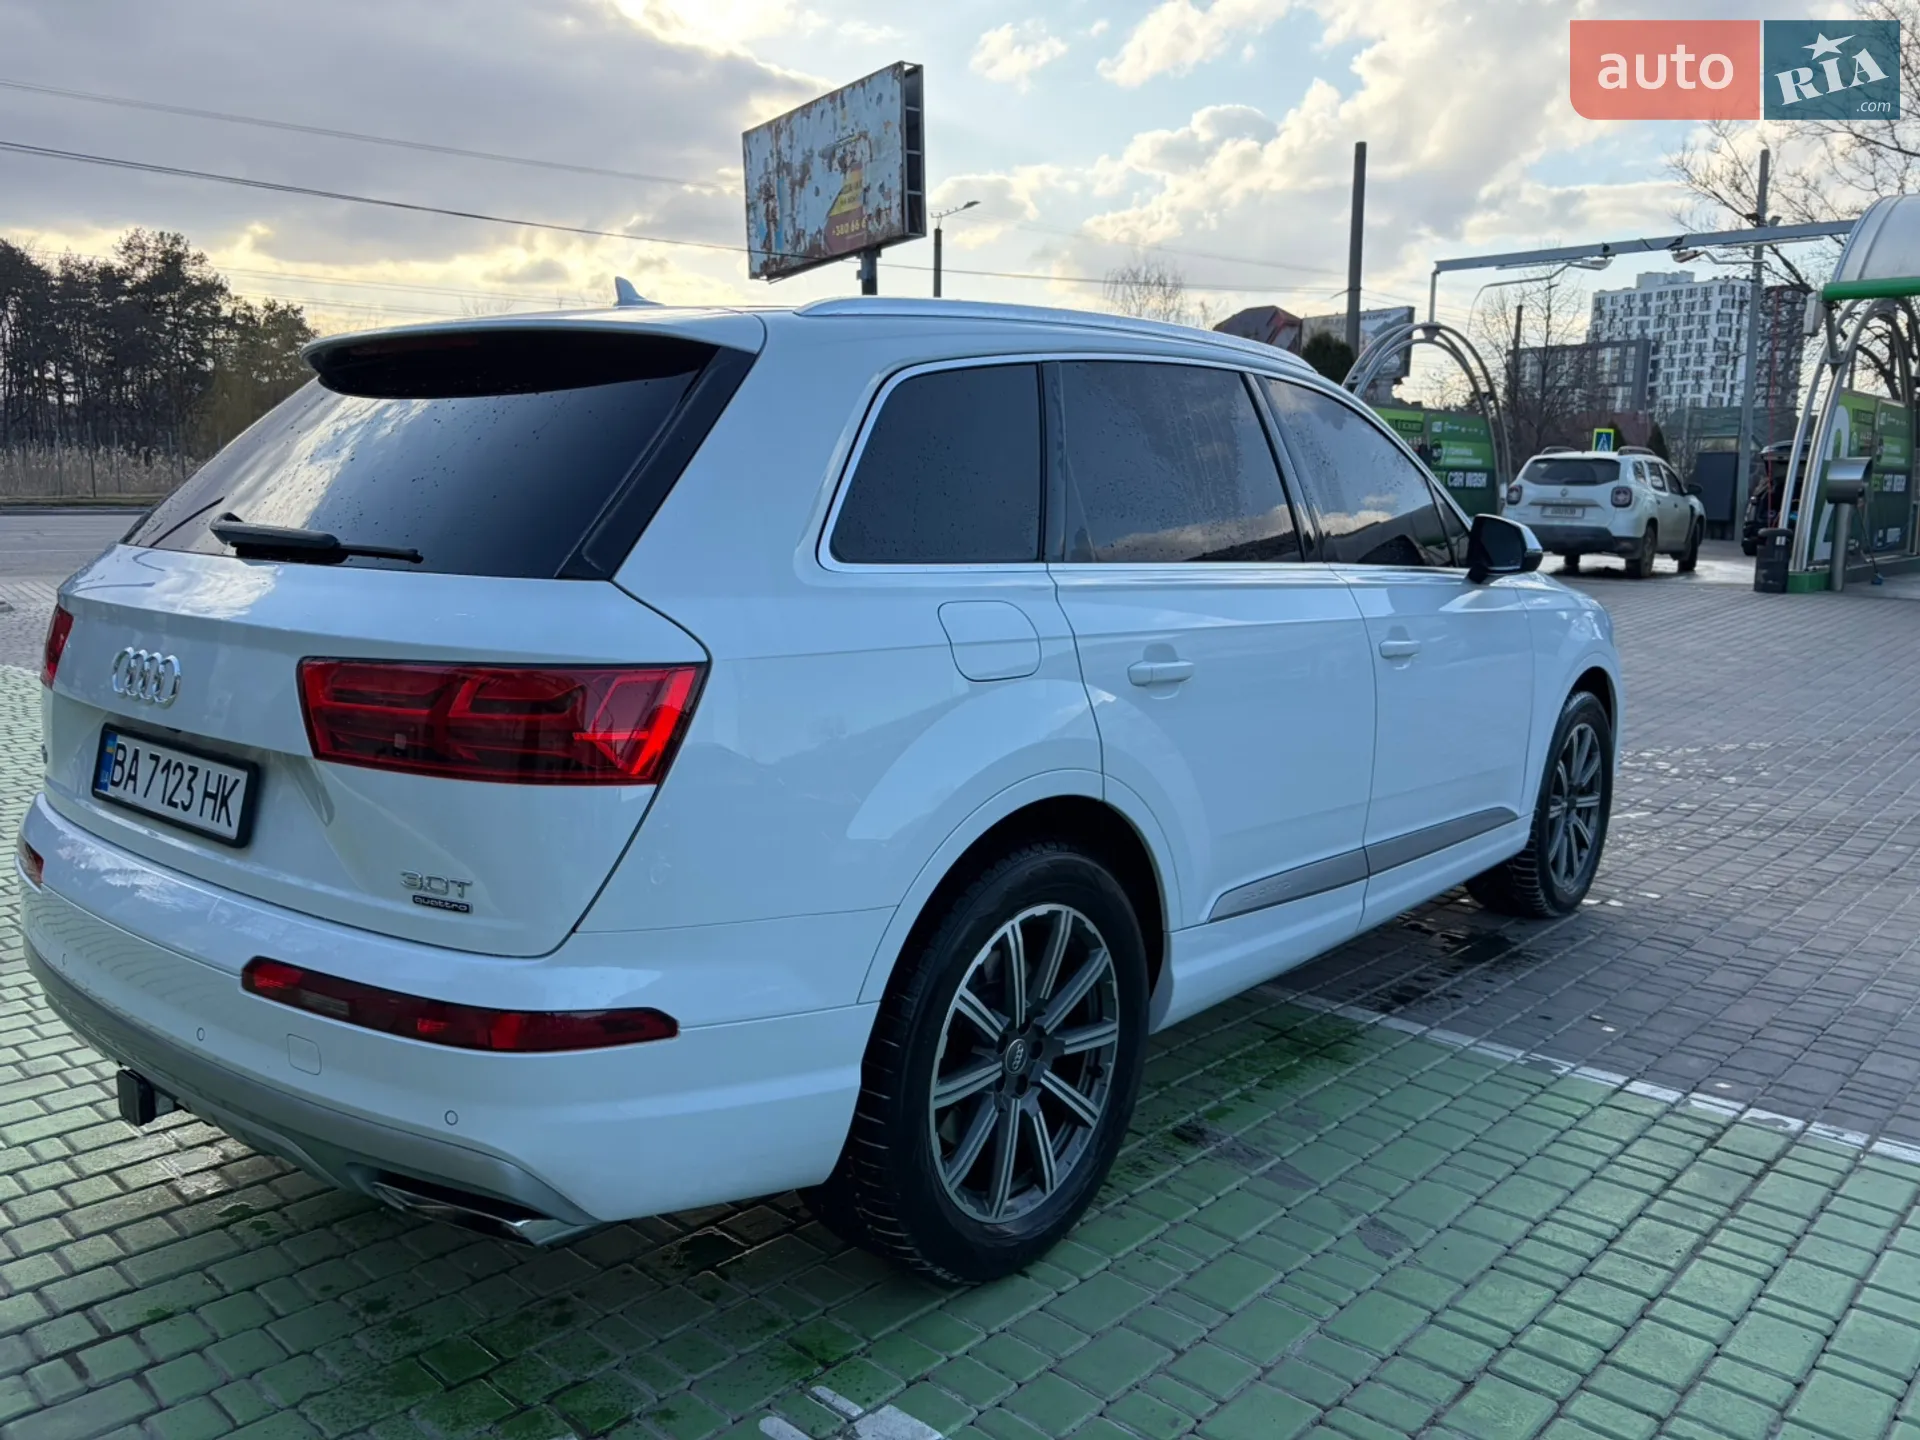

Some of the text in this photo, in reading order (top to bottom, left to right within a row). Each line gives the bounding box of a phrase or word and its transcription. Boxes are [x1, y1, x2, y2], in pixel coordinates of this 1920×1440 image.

[110, 742, 241, 828] BA 7123 HK
[414, 896, 468, 911] quattro
